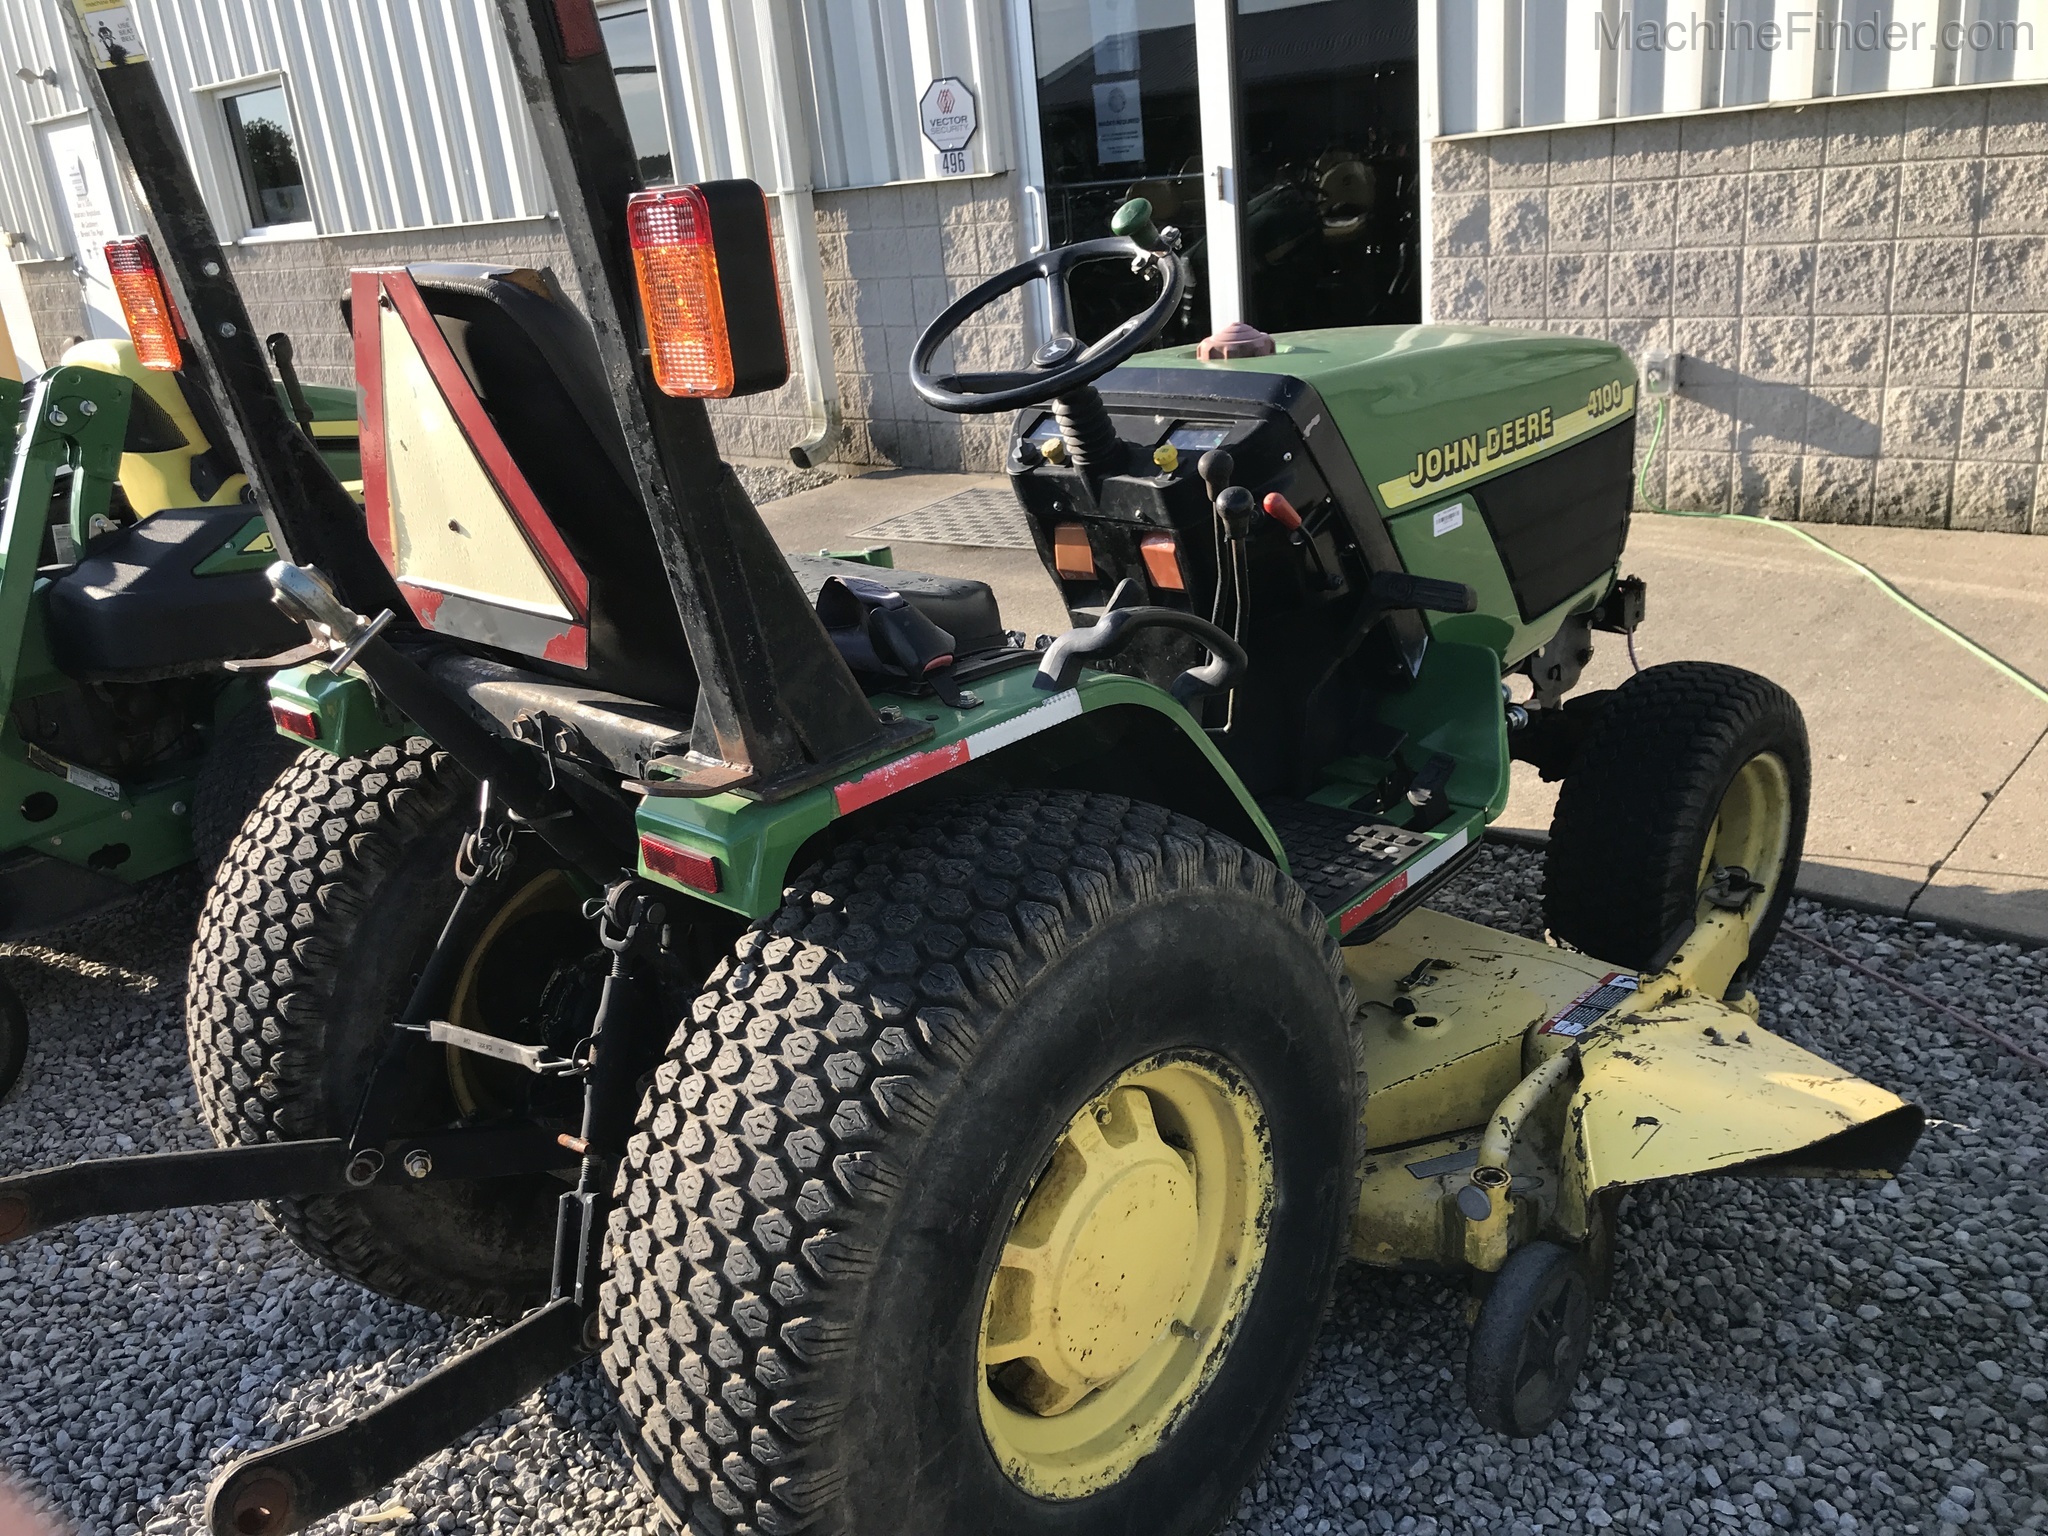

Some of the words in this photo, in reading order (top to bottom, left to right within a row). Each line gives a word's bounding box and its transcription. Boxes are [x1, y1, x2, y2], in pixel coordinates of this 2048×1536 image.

[119, 28, 133, 36] SEAT
[121, 34, 136, 42] BELT
[930, 115, 968, 127] VECTOR
[930, 124, 969, 135] SECURITY
[943, 152, 965, 174] 496
[1587, 379, 1623, 418] 4100
[1409, 433, 1480, 488] JOHN
[1486, 405, 1554, 459] DEERE
